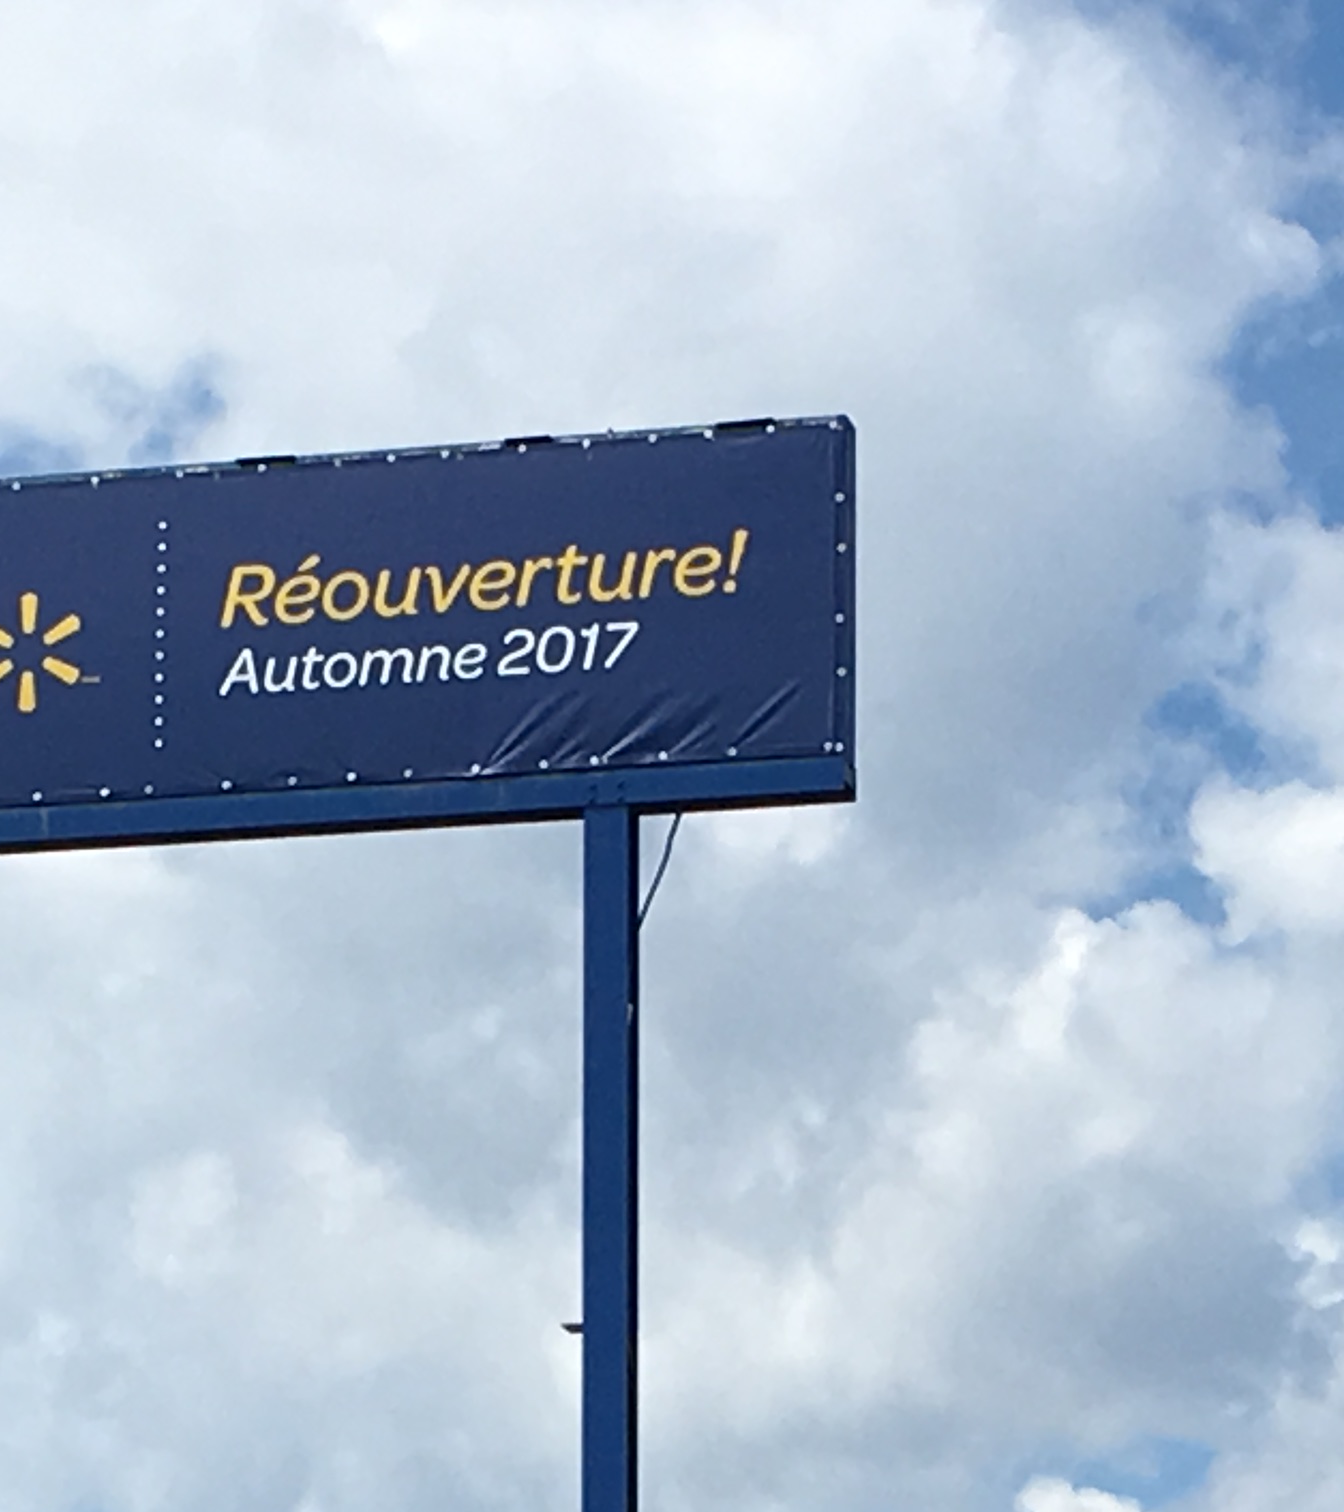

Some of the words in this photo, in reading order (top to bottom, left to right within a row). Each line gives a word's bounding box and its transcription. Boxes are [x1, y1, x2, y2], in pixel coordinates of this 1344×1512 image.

[221, 529, 748, 628] Réouverture!
[219, 641, 488, 697] Automne
[497, 621, 639, 676] 2017
